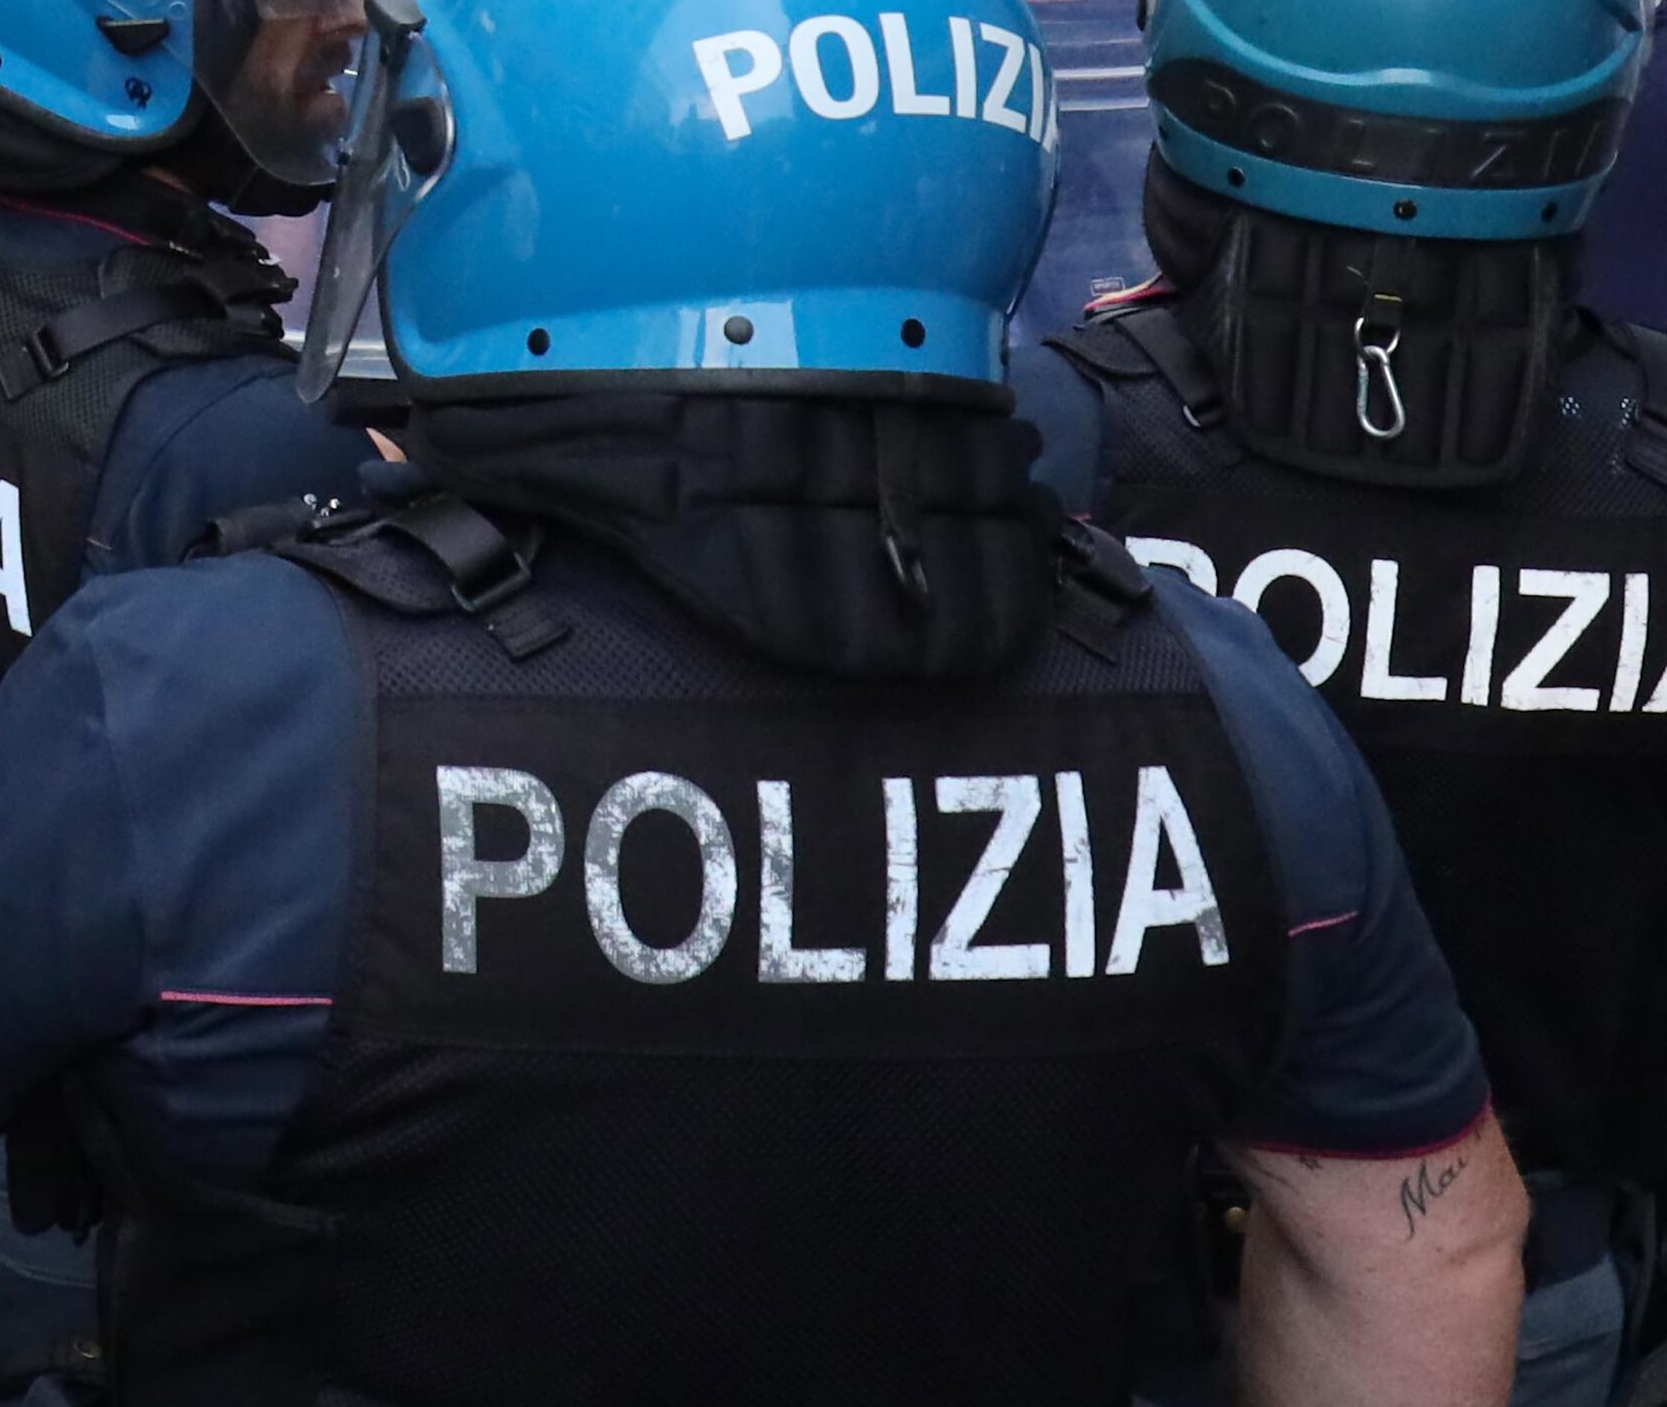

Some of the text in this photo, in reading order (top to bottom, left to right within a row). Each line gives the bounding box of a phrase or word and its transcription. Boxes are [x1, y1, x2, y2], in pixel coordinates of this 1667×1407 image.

[693, 13, 1062, 150] POLIZI
[1125, 535, 1667, 714] OLIZI
[436, 764, 1229, 986] POLIZIA
